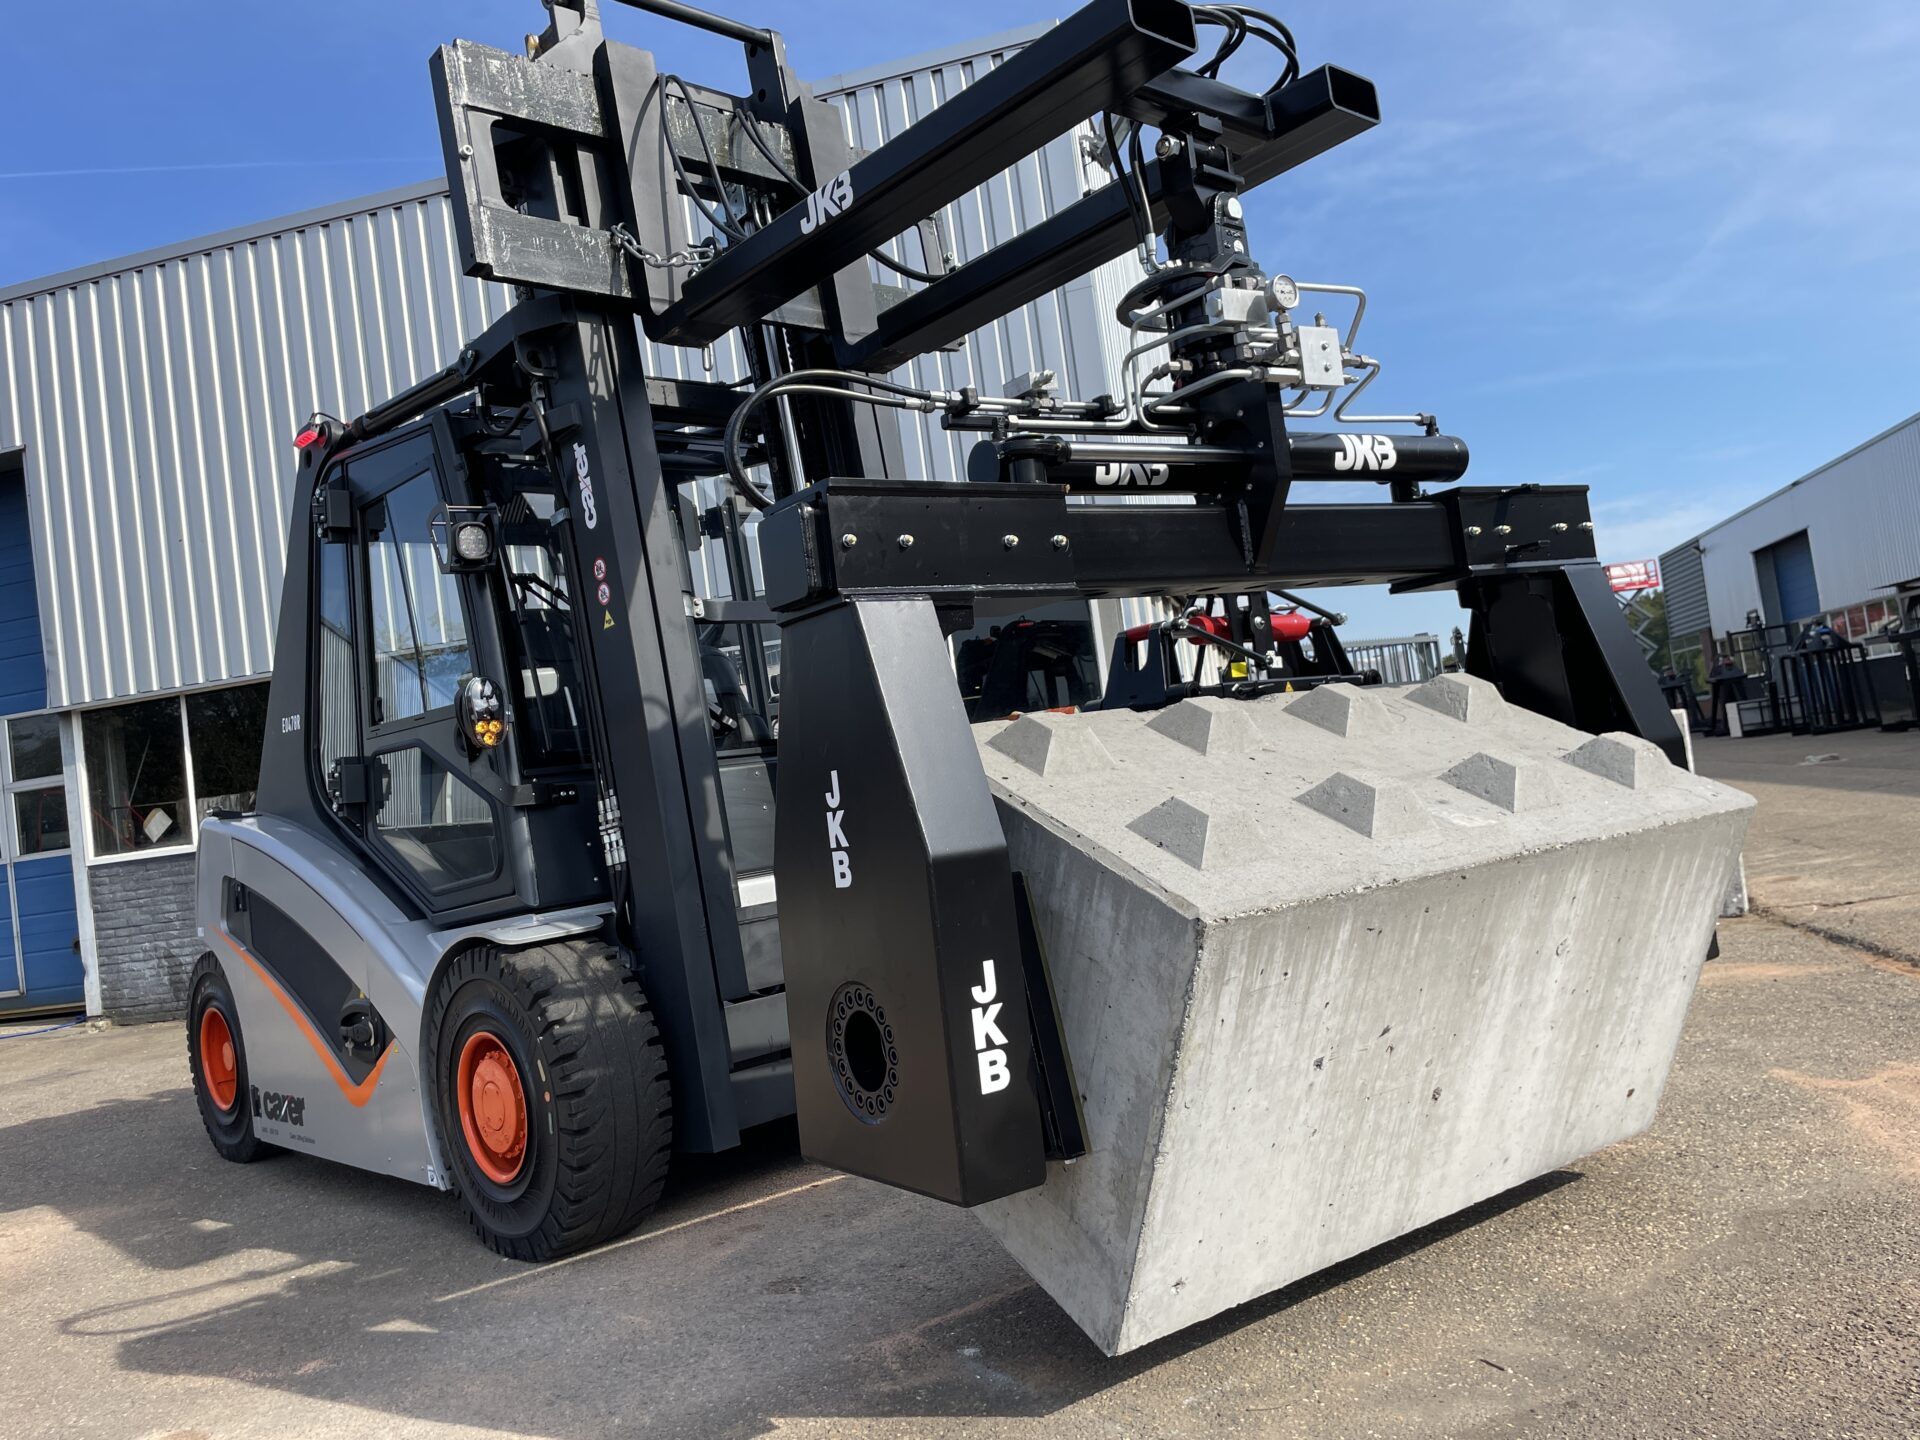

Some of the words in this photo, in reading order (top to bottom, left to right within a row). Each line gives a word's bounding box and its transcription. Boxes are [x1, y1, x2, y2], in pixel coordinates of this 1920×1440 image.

[800, 169, 854, 235] JKB
[573, 442, 597, 530] carer
[1334, 434, 1397, 471] JKB
[825, 769, 853, 889] JKB
[971, 959, 1011, 1096] JKB
